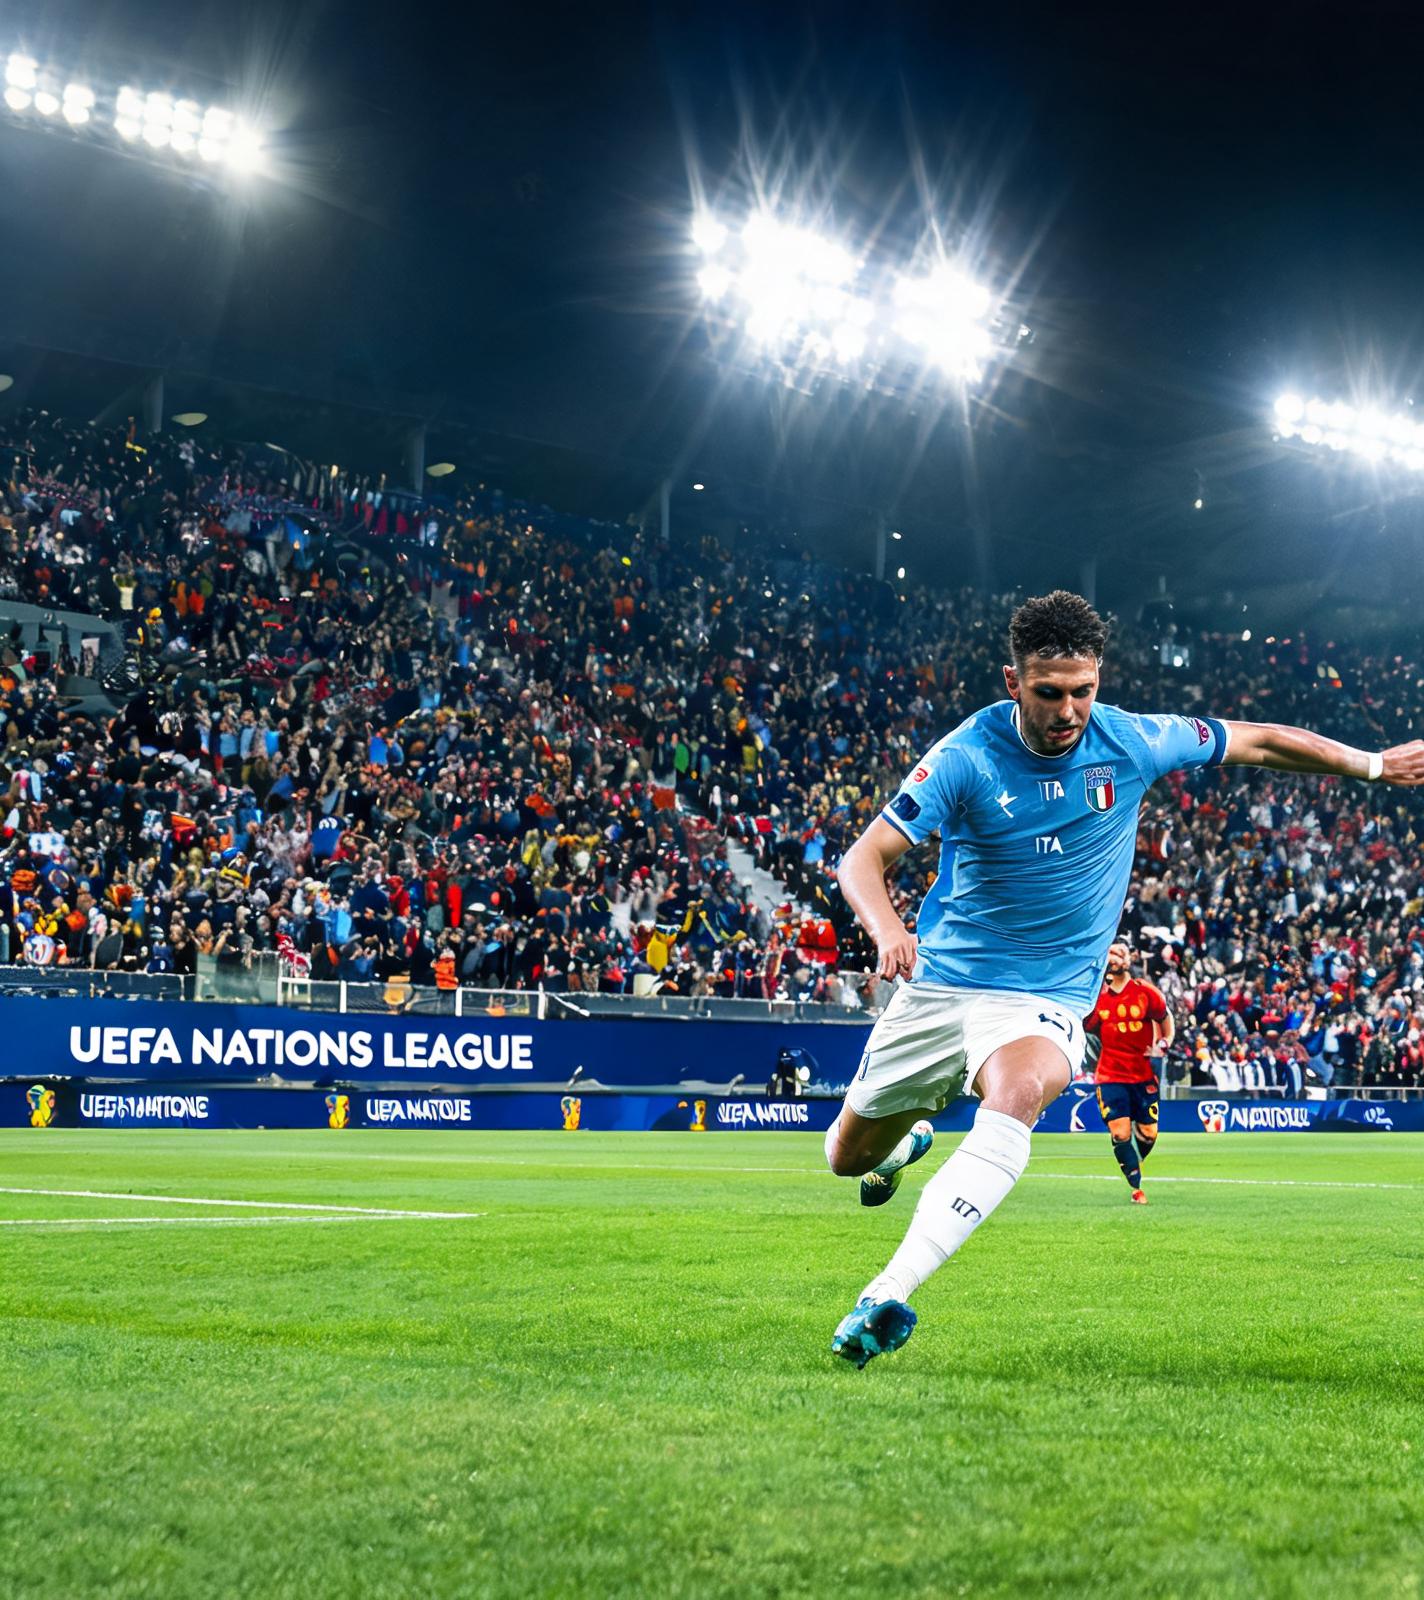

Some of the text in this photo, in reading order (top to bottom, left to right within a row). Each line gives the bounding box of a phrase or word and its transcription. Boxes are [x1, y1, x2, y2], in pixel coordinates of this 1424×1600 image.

[1036, 836, 1064, 855] ITA
[71, 1027, 533, 1069] UEFA NATIONS LEAGUE
